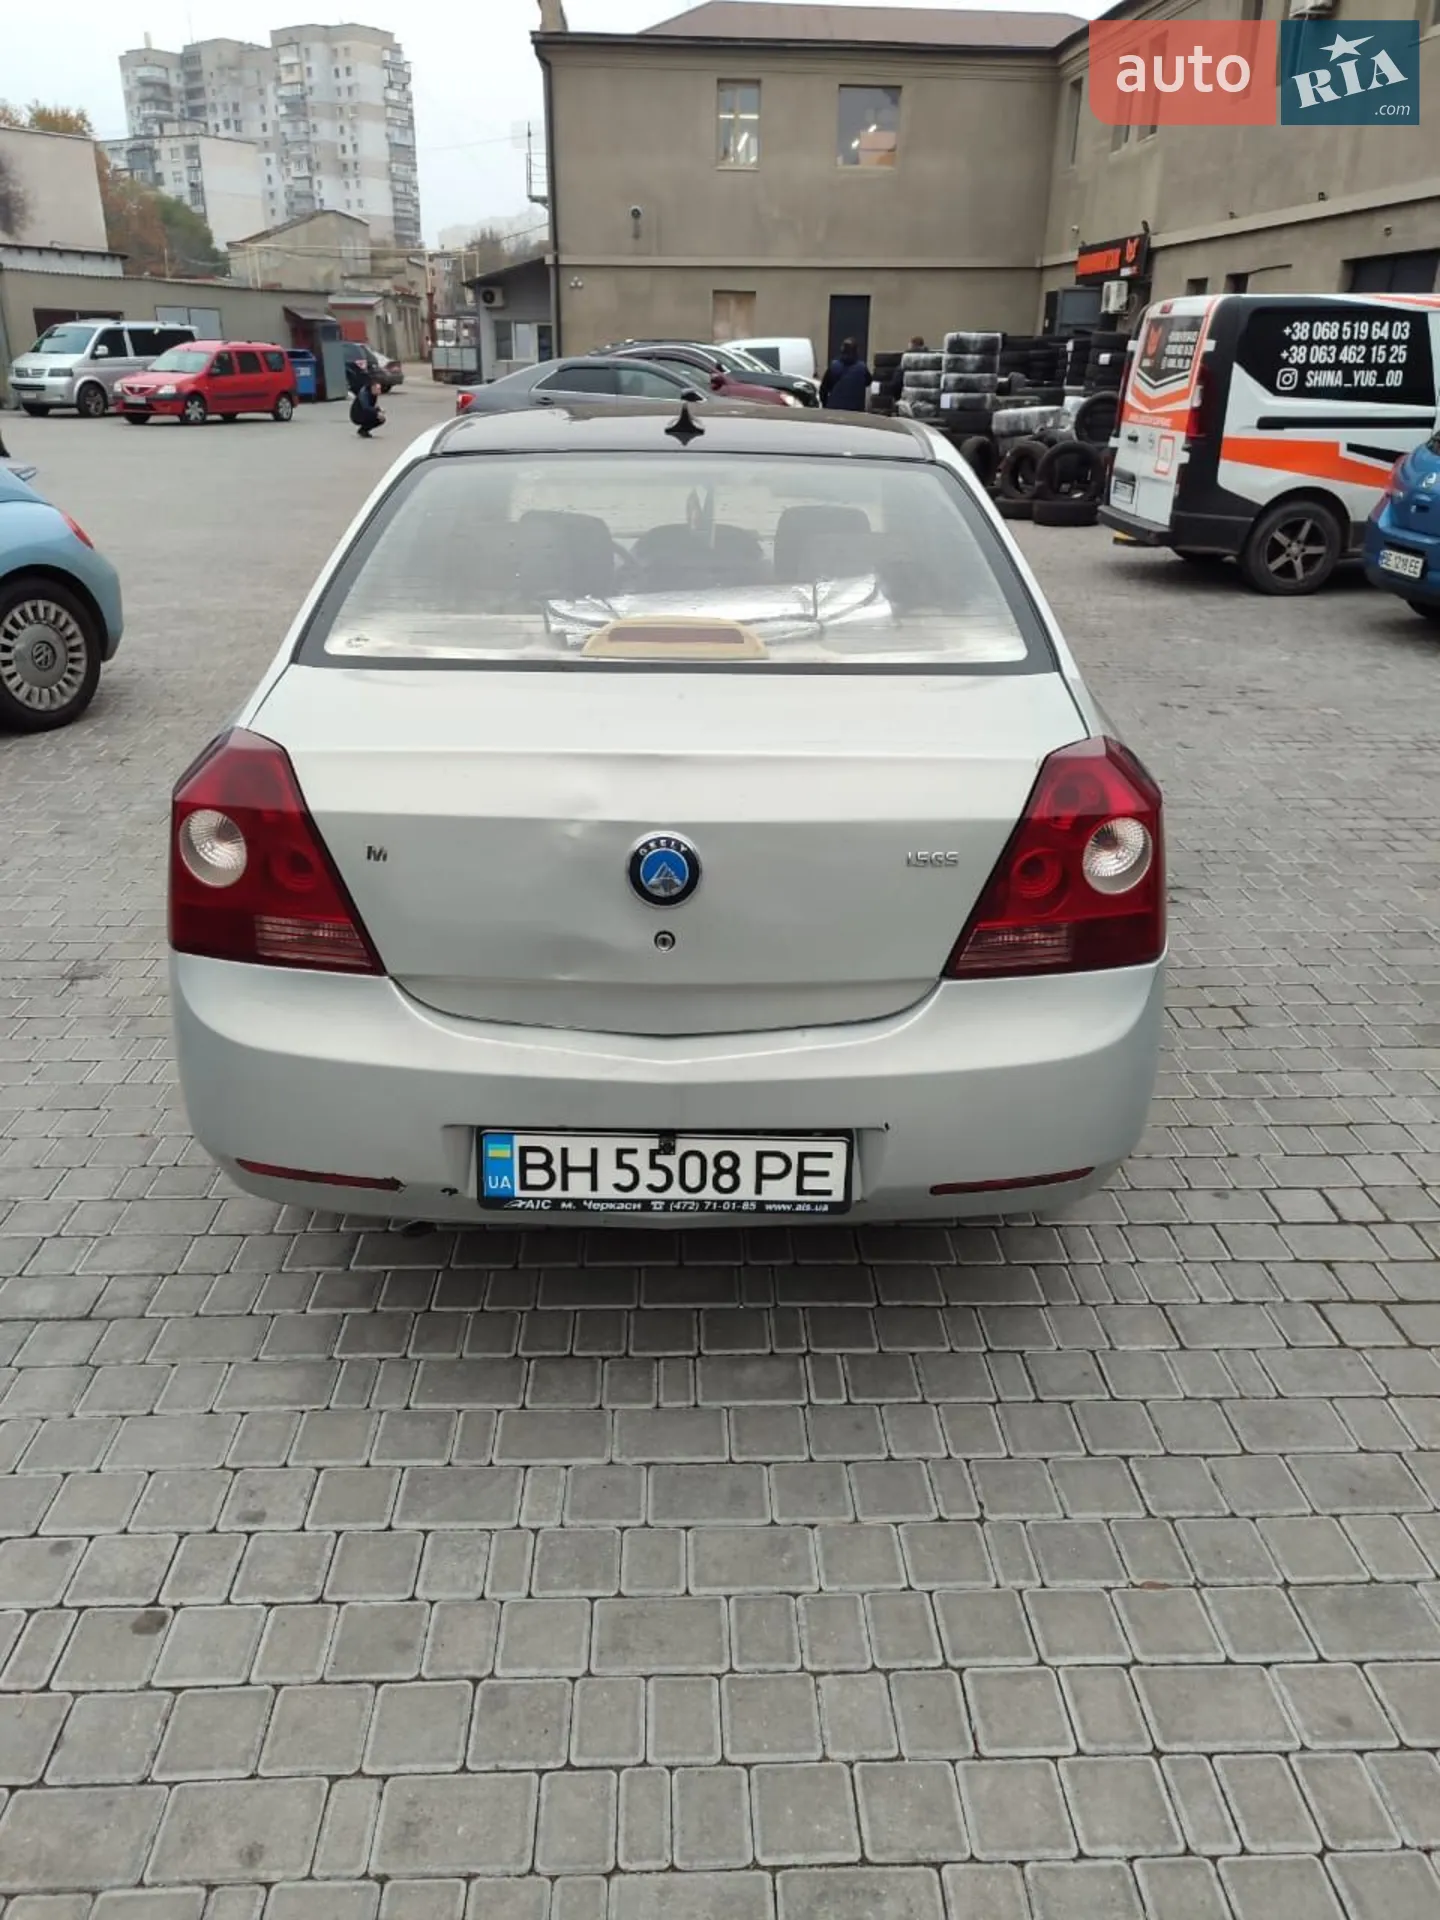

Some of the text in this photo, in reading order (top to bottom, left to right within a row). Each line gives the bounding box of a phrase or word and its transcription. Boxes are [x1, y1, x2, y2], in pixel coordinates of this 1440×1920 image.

[1283, 321, 1410, 340] +38 068 519 64 03
[1280, 344, 1407, 364] +38 063 462 15 25
[1305, 369, 1403, 388] SHINA_YUG_OD
[518, 1145, 834, 1197] BH 5508 PE
[488, 1175, 512, 1189] UA
[669, 1201, 699, 1211] (472)
[704, 1201, 757, 1211] 71-01-85
[765, 1202, 829, 1212] www.ais.ua
